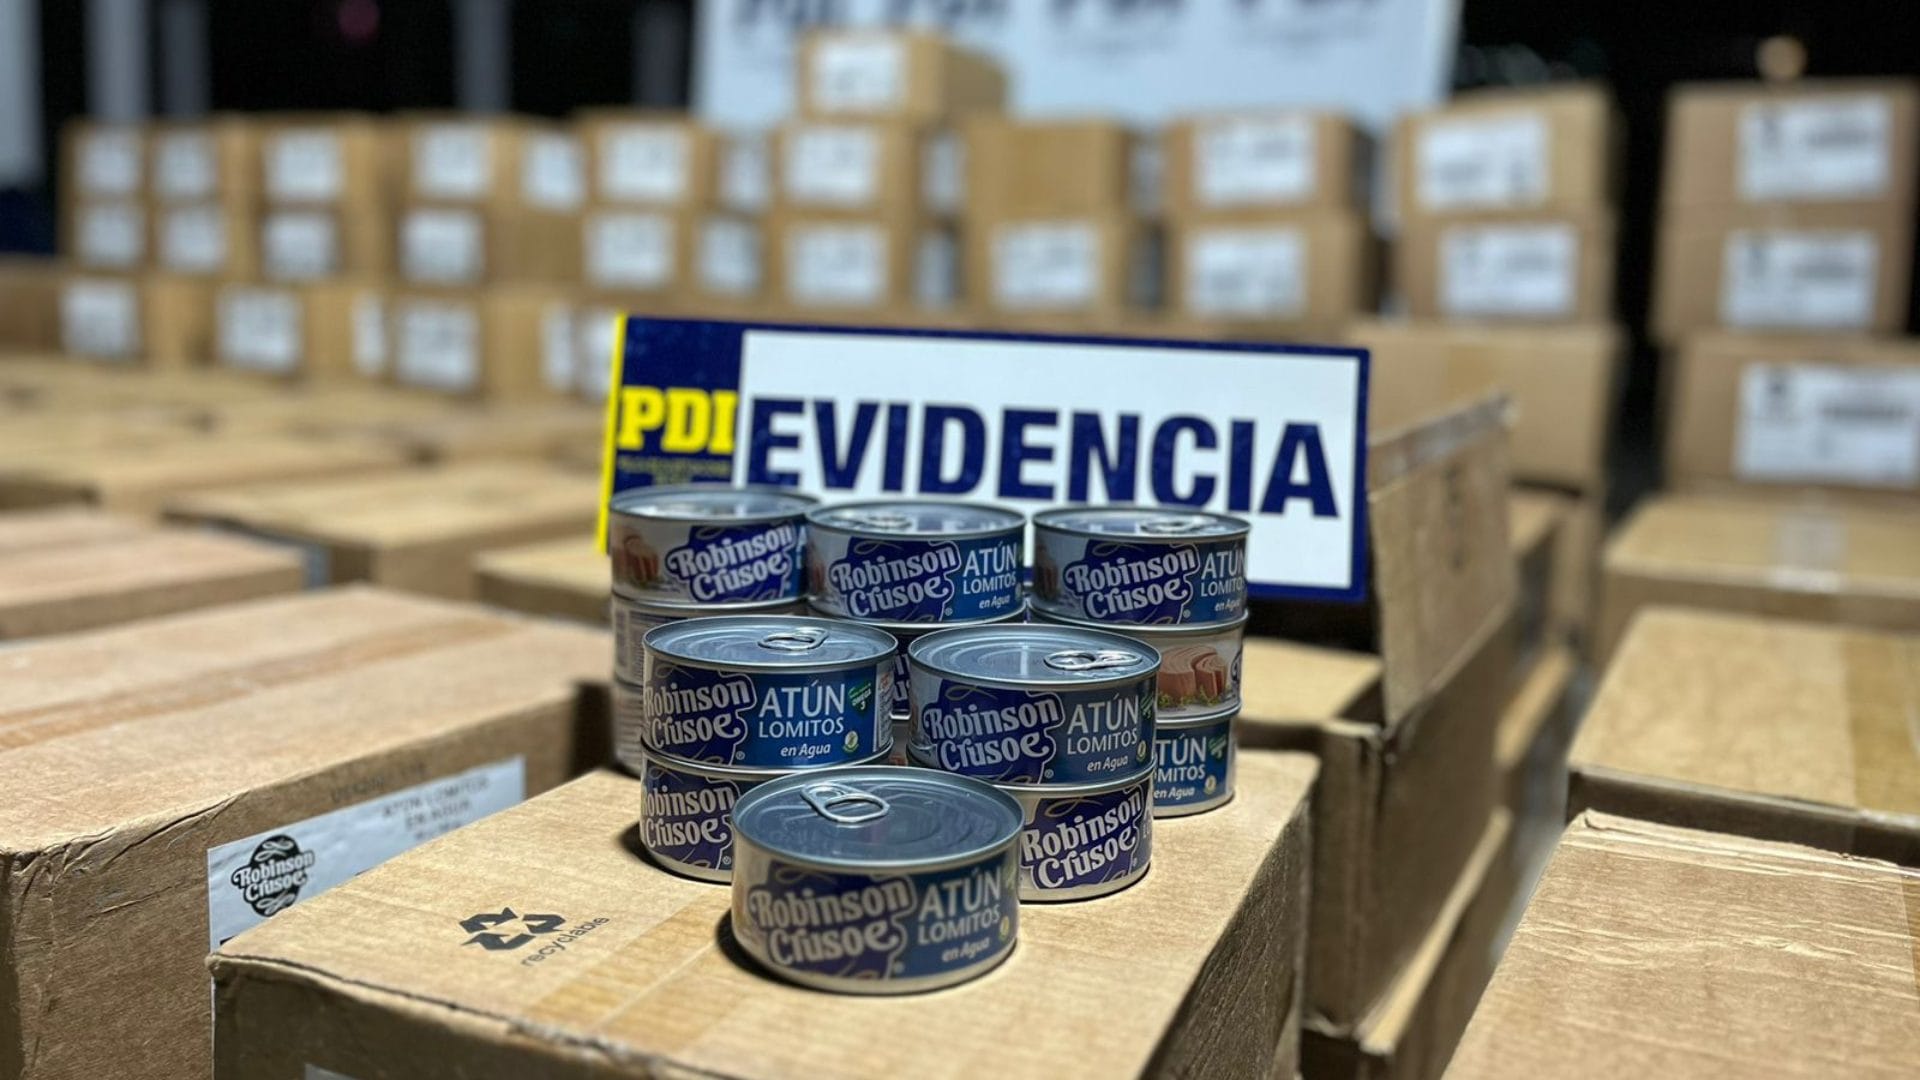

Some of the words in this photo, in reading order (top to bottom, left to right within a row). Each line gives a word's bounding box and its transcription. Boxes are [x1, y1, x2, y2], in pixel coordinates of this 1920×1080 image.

[617, 386, 740, 454] PDI
[747, 396, 1340, 518] EVIDENCIA
[666, 525, 794, 578] Robinson
[831, 546, 957, 591] Robinson
[963, 541, 1018, 577] ATÚN
[1065, 549, 1198, 593] Robinson
[692, 552, 788, 600] Crusoe
[849, 574, 949, 617] Crusoe
[963, 572, 1017, 595] LOMITOS
[979, 599, 992, 609] en
[991, 594, 1010, 609] Agua
[1086, 578, 1189, 619] Crusoe
[642, 680, 751, 717] Robinson
[758, 679, 845, 718] ATÚN
[923, 698, 1062, 739] Robinson
[1066, 692, 1139, 735] ATÚN
[652, 713, 742, 749] Crusoe
[758, 716, 845, 739] LOMITOS
[1066, 727, 1138, 755] LOMITOS
[780, 745, 800, 757] en
[800, 743, 831, 760] Agua
[940, 730, 1050, 772] Crusoe
[1087, 760, 1101, 772] en
[1102, 755, 1129, 772] Agua
[1155, 732, 1207, 766] TÚN
[645, 785, 736, 817] obinson
[1154, 789, 1167, 799] en
[1168, 785, 1196, 800] Agua
[646, 818, 728, 848] Crusoe
[1021, 791, 1142, 862] Robinson
[233, 851, 314, 887] Robinson
[1037, 825, 1137, 889] Crusoe
[245, 869, 307, 902] Crusoe
[750, 879, 910, 928] Robinson
[918, 866, 1000, 922] ATÚN
[520, 917, 611, 967] recyclable
[770, 919, 899, 965] Crusoe
[918, 903, 1000, 945] LOMITOS
[941, 947, 960, 962] en
[959, 937, 990, 960] Agua
